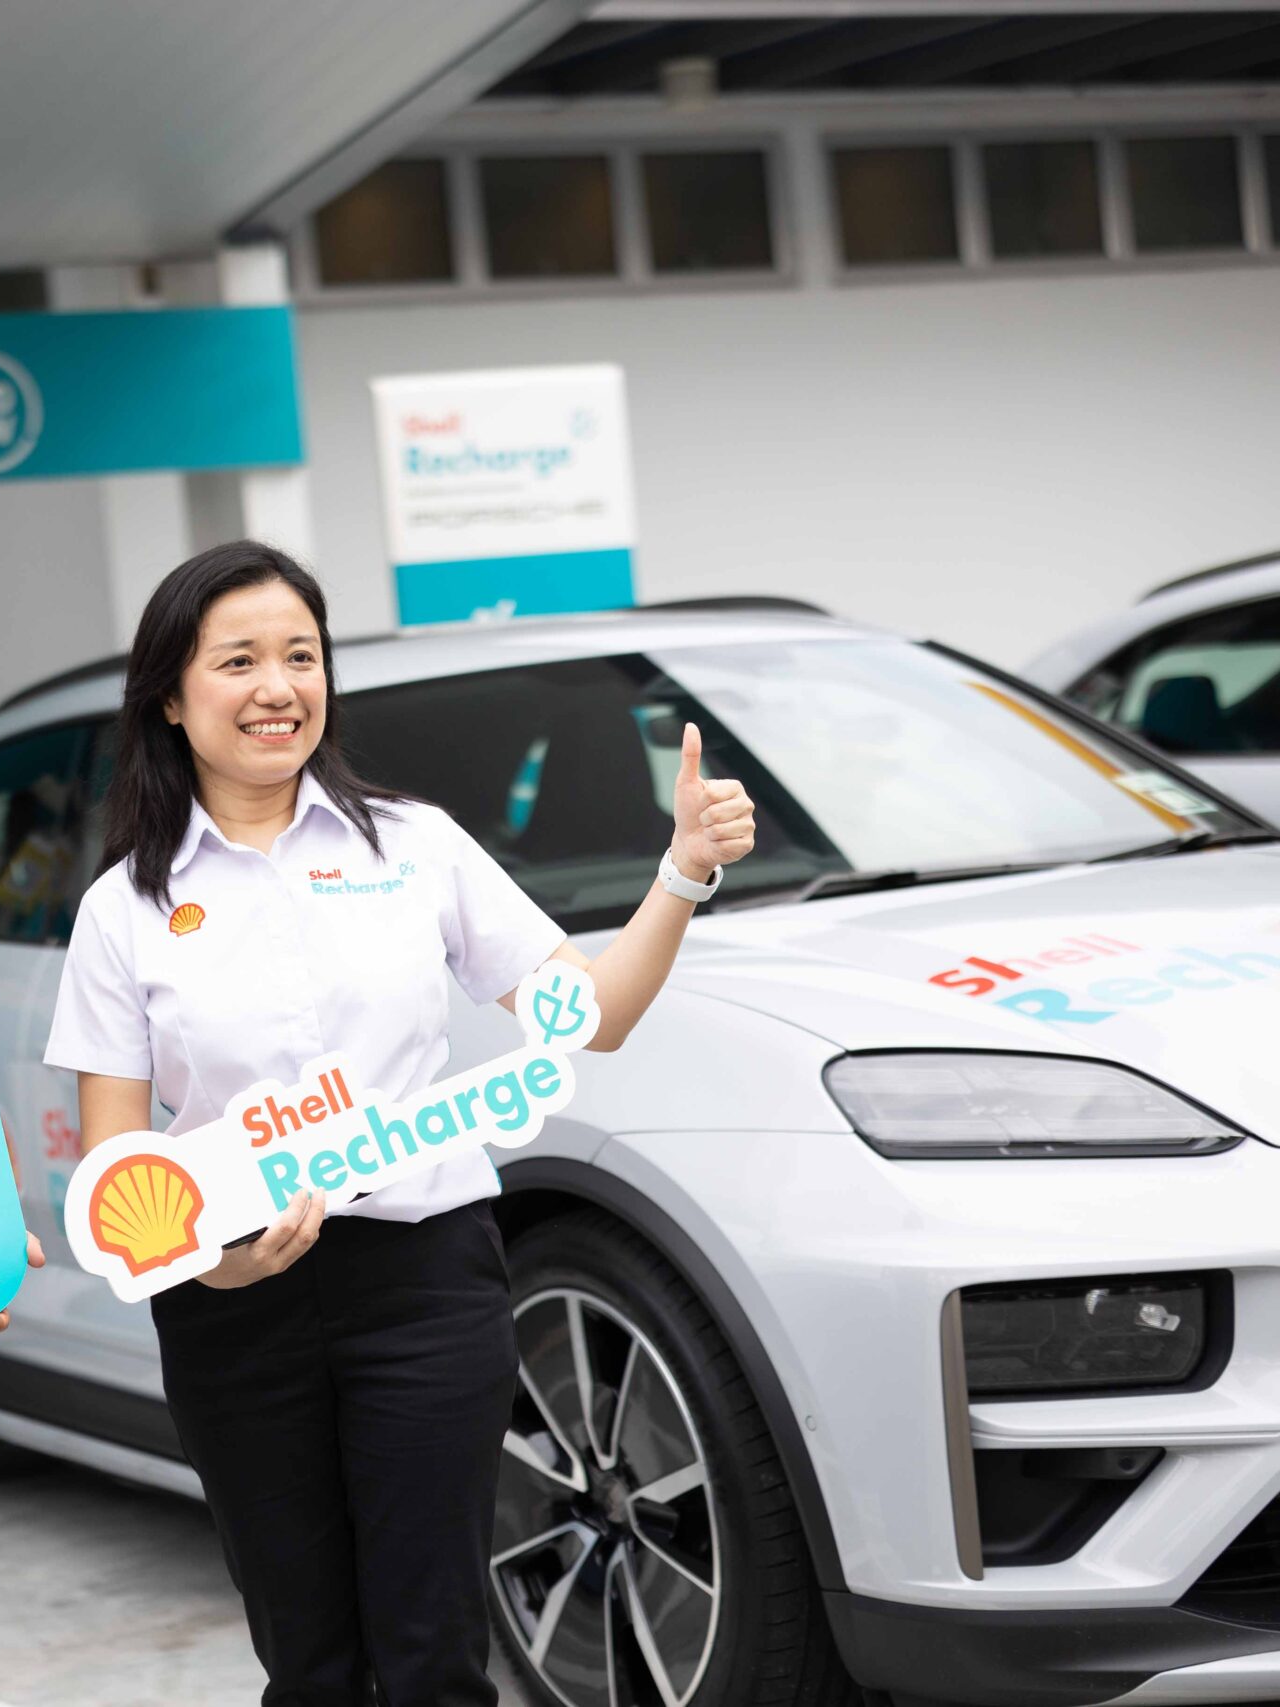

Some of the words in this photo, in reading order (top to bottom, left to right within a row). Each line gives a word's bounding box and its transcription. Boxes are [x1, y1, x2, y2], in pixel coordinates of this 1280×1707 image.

[404, 444, 571, 478] Recharge
[308, 868, 343, 881] Shell
[311, 879, 405, 896] Recharge
[927, 933, 1144, 997] Shell
[242, 1068, 355, 1148] Shell
[257, 1058, 561, 1212] Recharge
